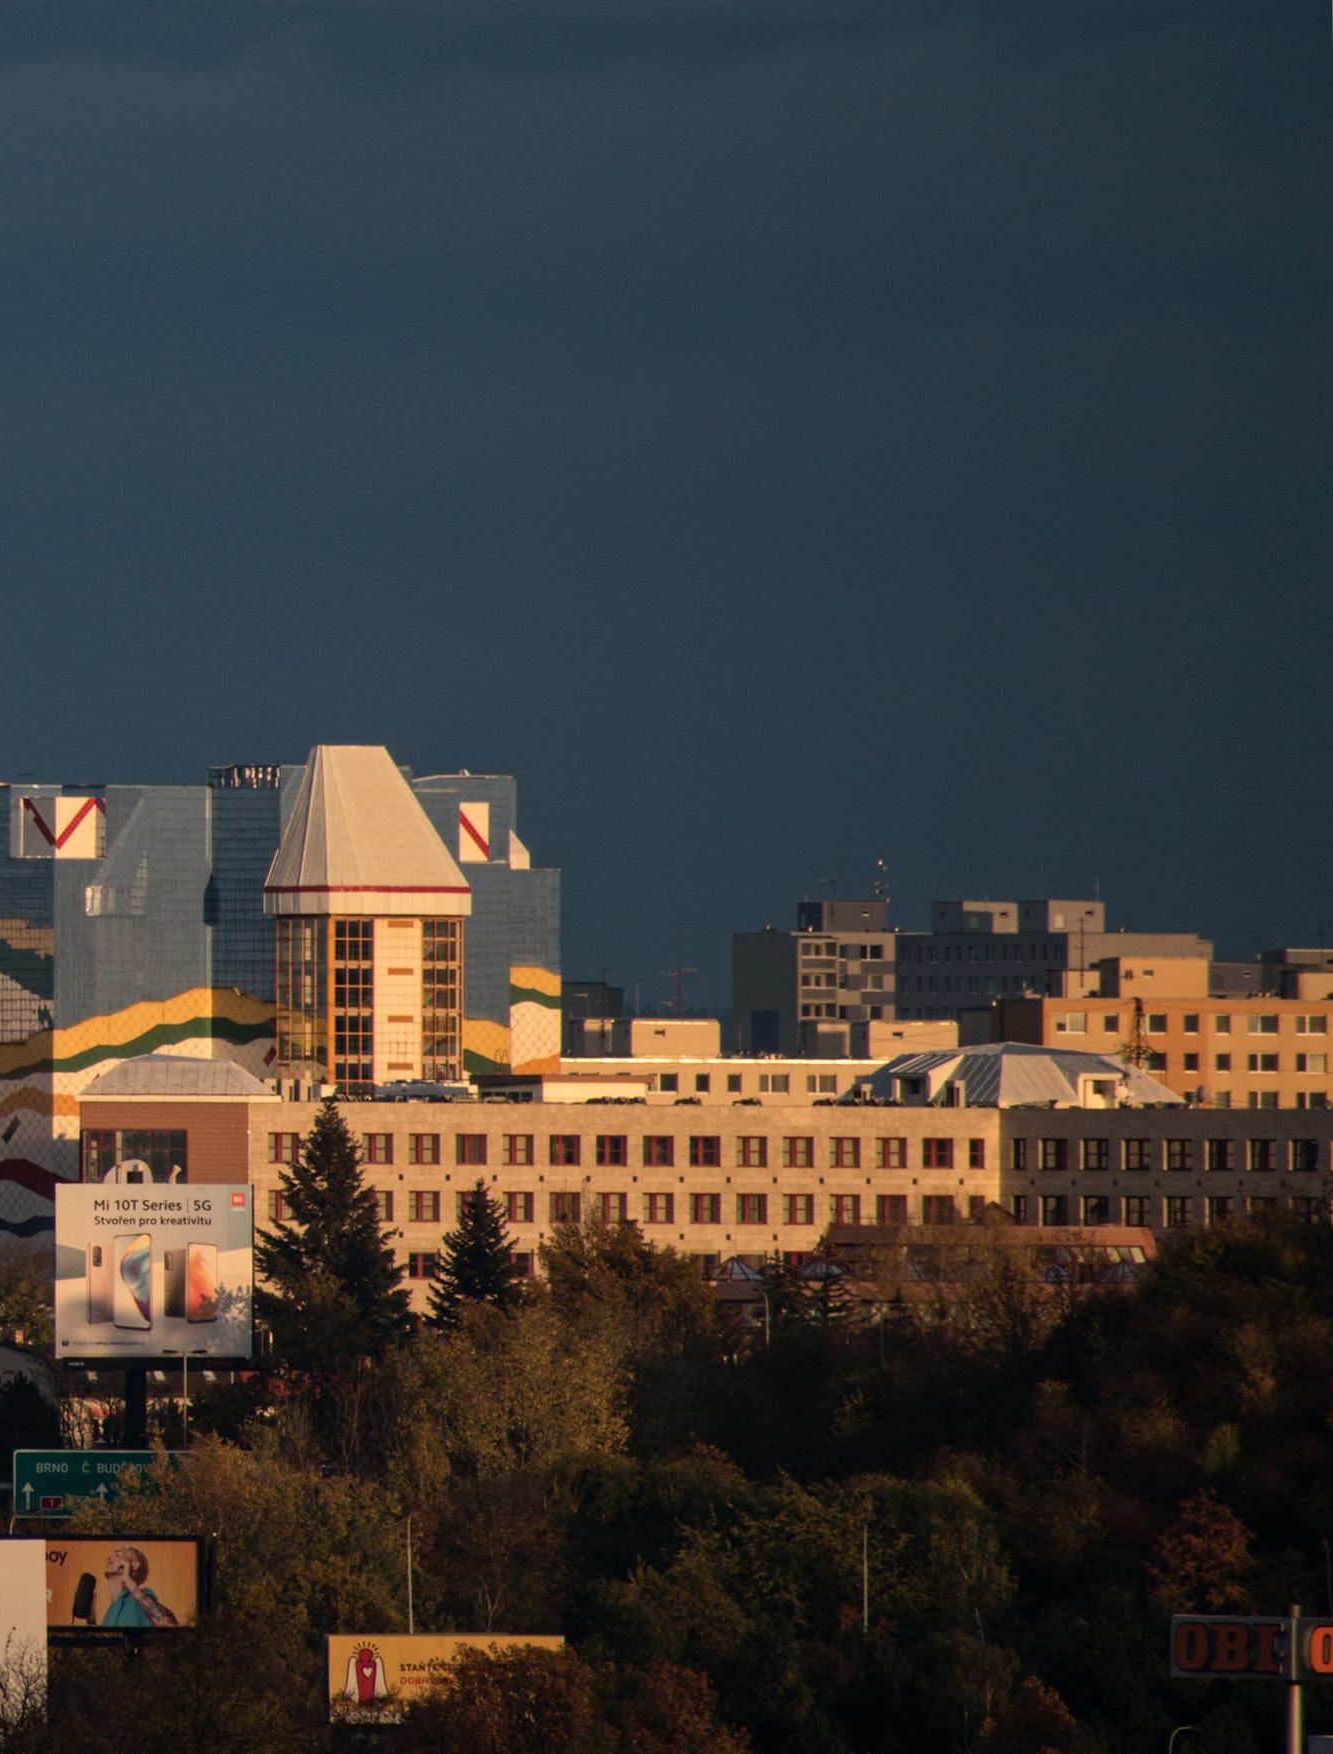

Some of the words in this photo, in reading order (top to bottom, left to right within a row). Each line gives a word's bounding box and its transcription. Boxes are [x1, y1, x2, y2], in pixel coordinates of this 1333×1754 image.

[94, 1200, 110, 1211] Mi
[115, 1200, 139, 1211] 10T
[142, 1199, 182, 1211] Series
[193, 1200, 212, 1211] 5G
[94, 1215, 136, 1226] Stvořen
[139, 1218, 157, 1228] pro
[160, 1216, 212, 1226] kreativitu
[35, 1462, 69, 1474] BRNO
[45, 1550, 68, 1566] oy
[1175, 1622, 1282, 1673] OBI
